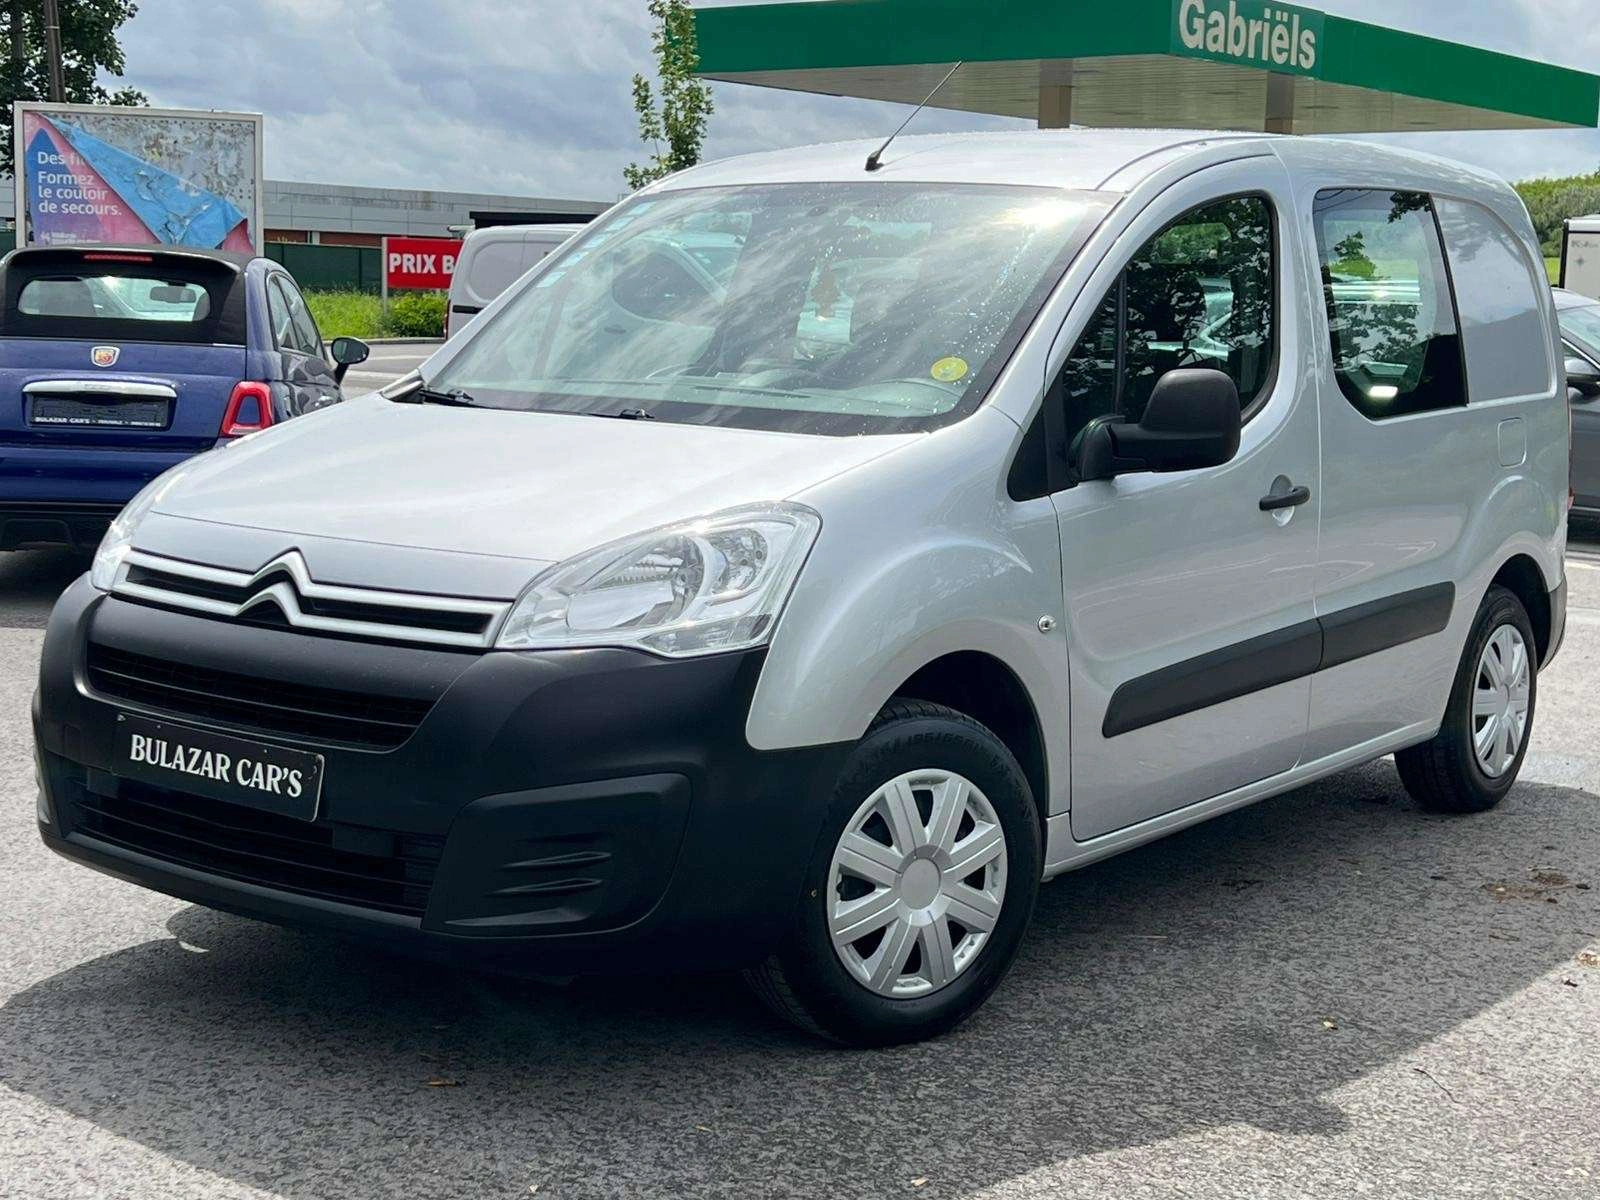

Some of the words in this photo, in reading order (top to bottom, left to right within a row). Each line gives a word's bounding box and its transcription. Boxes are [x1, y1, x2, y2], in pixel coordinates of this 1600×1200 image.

[1178, 0, 1316, 69] Gabriëls
[37, 151, 65, 165] Des
[37, 171, 94, 185] Formez
[38, 185, 52, 198] le
[56, 186, 108, 201] couloir
[39, 199, 57, 213] de
[61, 202, 122, 216] secours.
[389, 253, 436, 274] PRIX
[130, 734, 232, 783] BULAZAR
[235, 758, 303, 798] CAR'S
